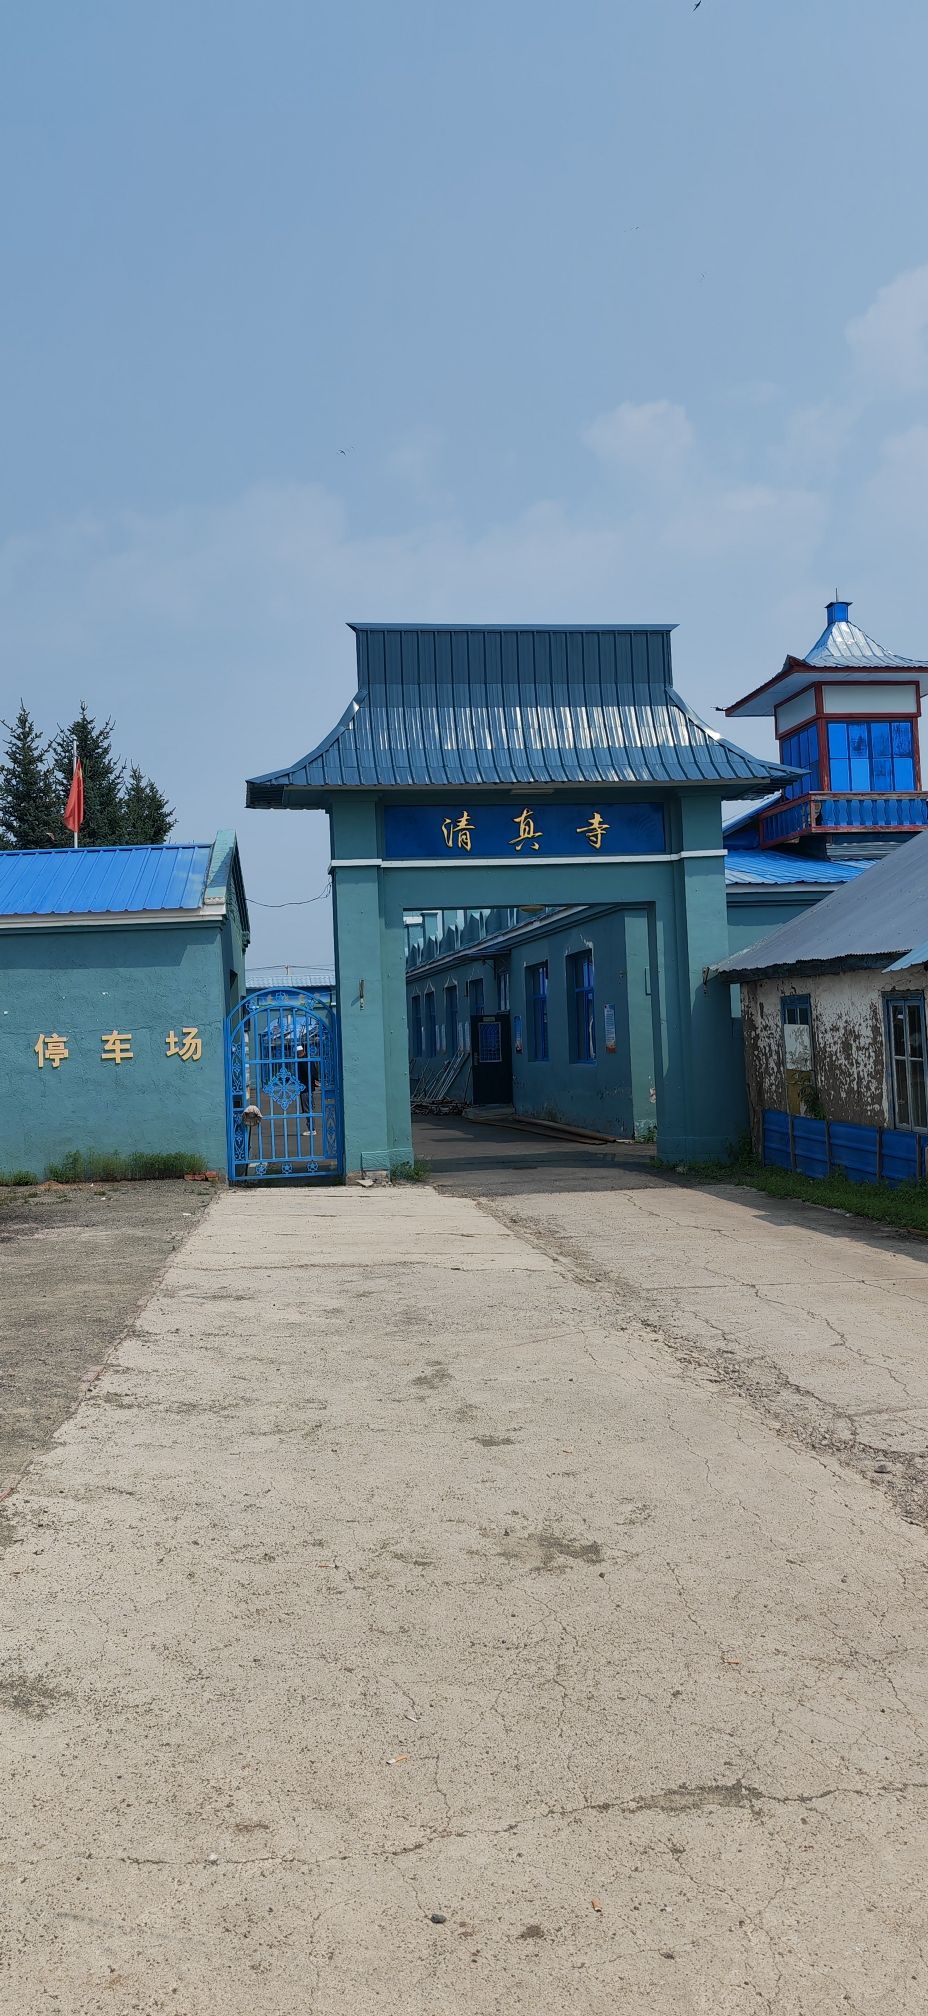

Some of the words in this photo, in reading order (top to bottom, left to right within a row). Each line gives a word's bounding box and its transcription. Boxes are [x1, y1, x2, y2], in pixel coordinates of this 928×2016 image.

[441, 808, 610, 851] 清真寺
[34, 1027, 202, 1068] 停车场
